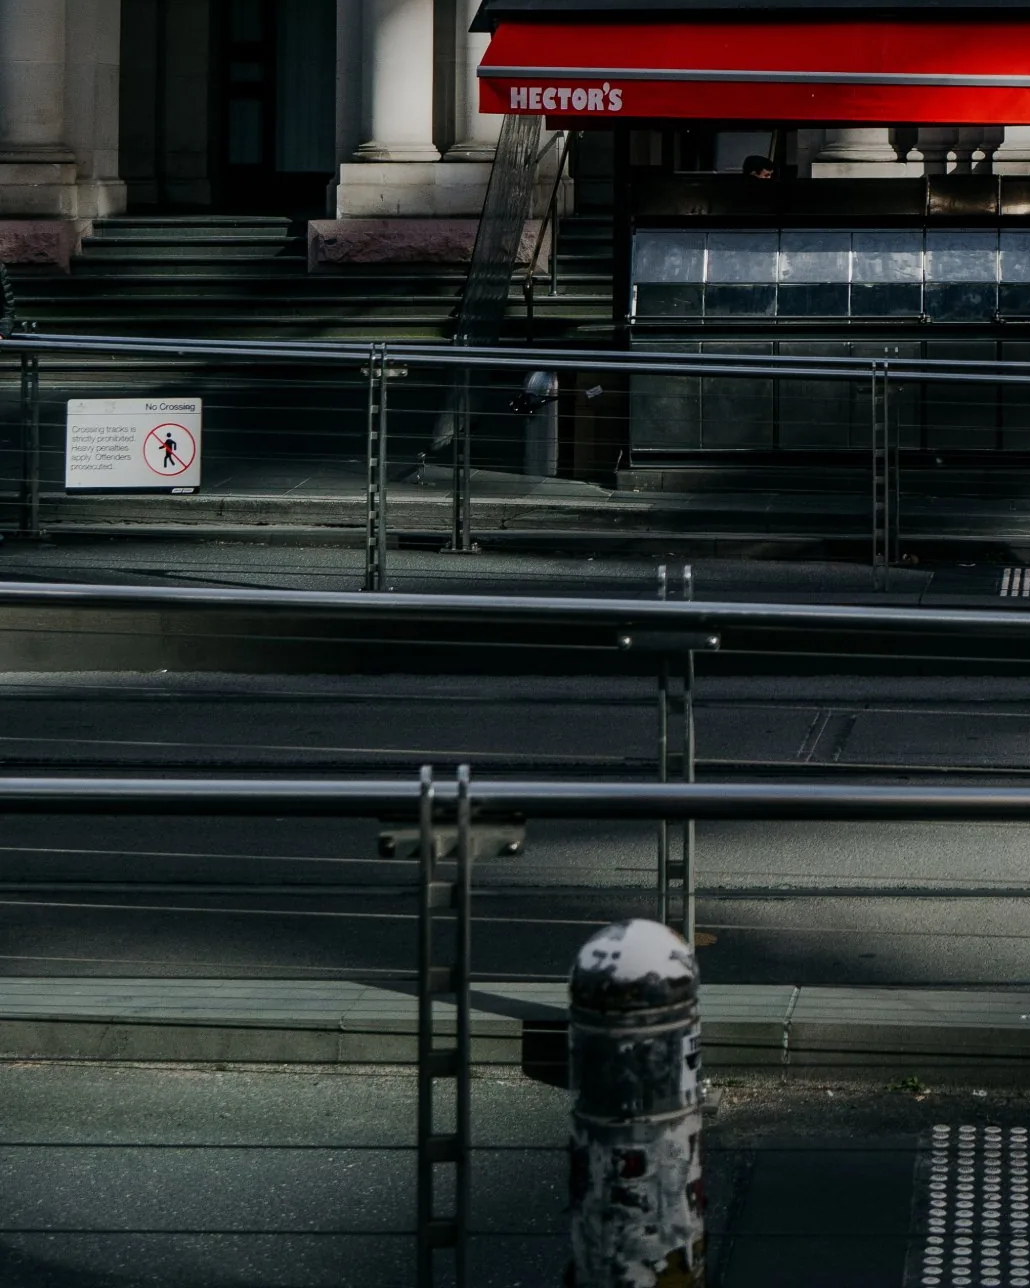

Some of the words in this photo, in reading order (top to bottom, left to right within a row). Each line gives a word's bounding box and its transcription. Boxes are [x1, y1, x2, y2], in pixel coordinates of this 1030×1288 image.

[510, 81, 623, 112] HECTOR'S
[145, 403, 158, 411] No
[160, 402, 196, 411] Crossing
[71, 425, 105, 434] Crossing
[106, 425, 129, 433] tracks
[131, 425, 136, 433] is
[71, 435, 95, 443] strictly
[71, 444, 95, 453] Heavy
[96, 444, 129, 453] penalties
[95, 453, 132, 461] Offenders
